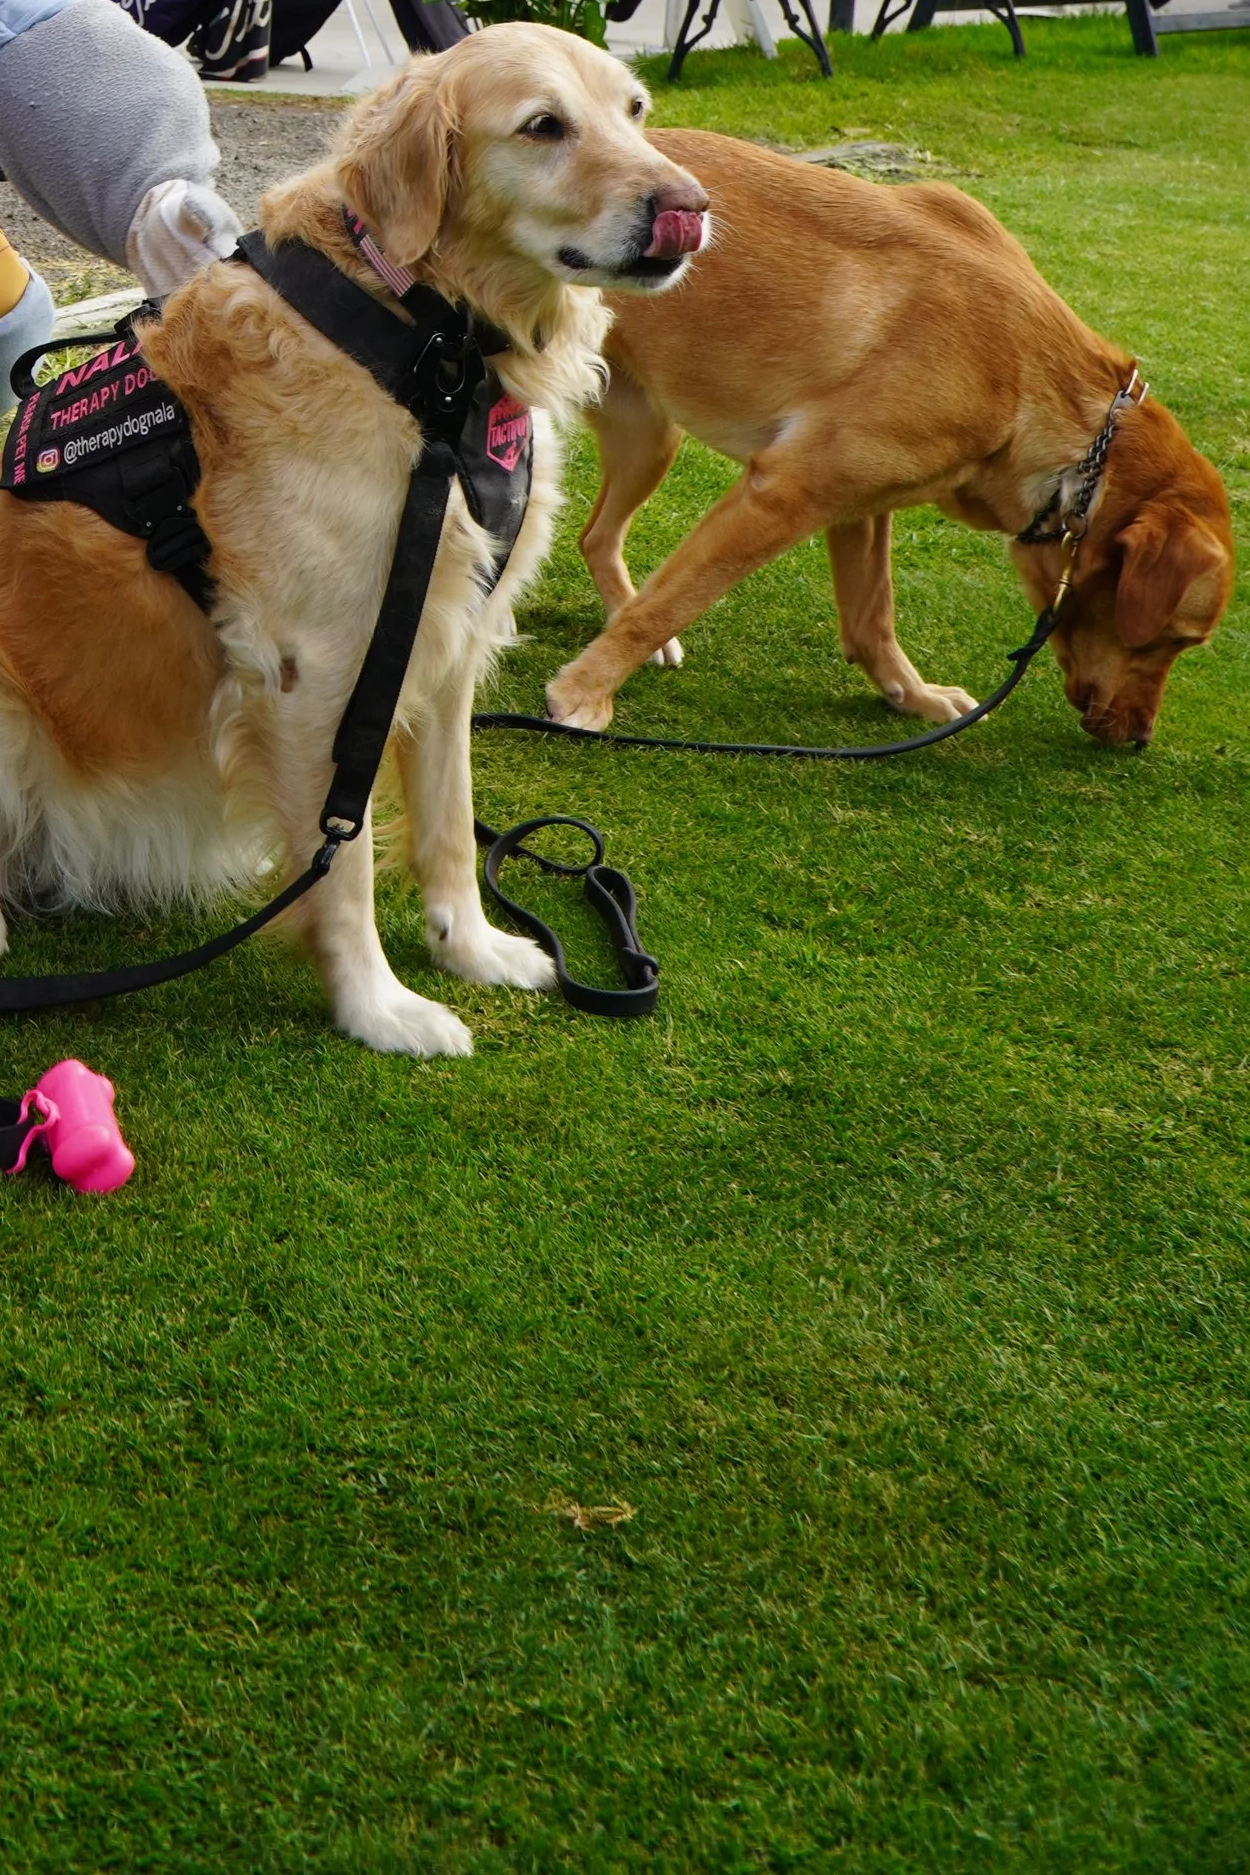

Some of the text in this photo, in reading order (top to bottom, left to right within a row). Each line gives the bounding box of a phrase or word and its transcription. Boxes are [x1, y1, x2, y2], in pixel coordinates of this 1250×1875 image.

[50, 380, 121, 430] THERAPY
[14, 434, 28, 461] PET
[64, 401, 175, 464] @therapydognala
[13, 461, 26, 485] ME
